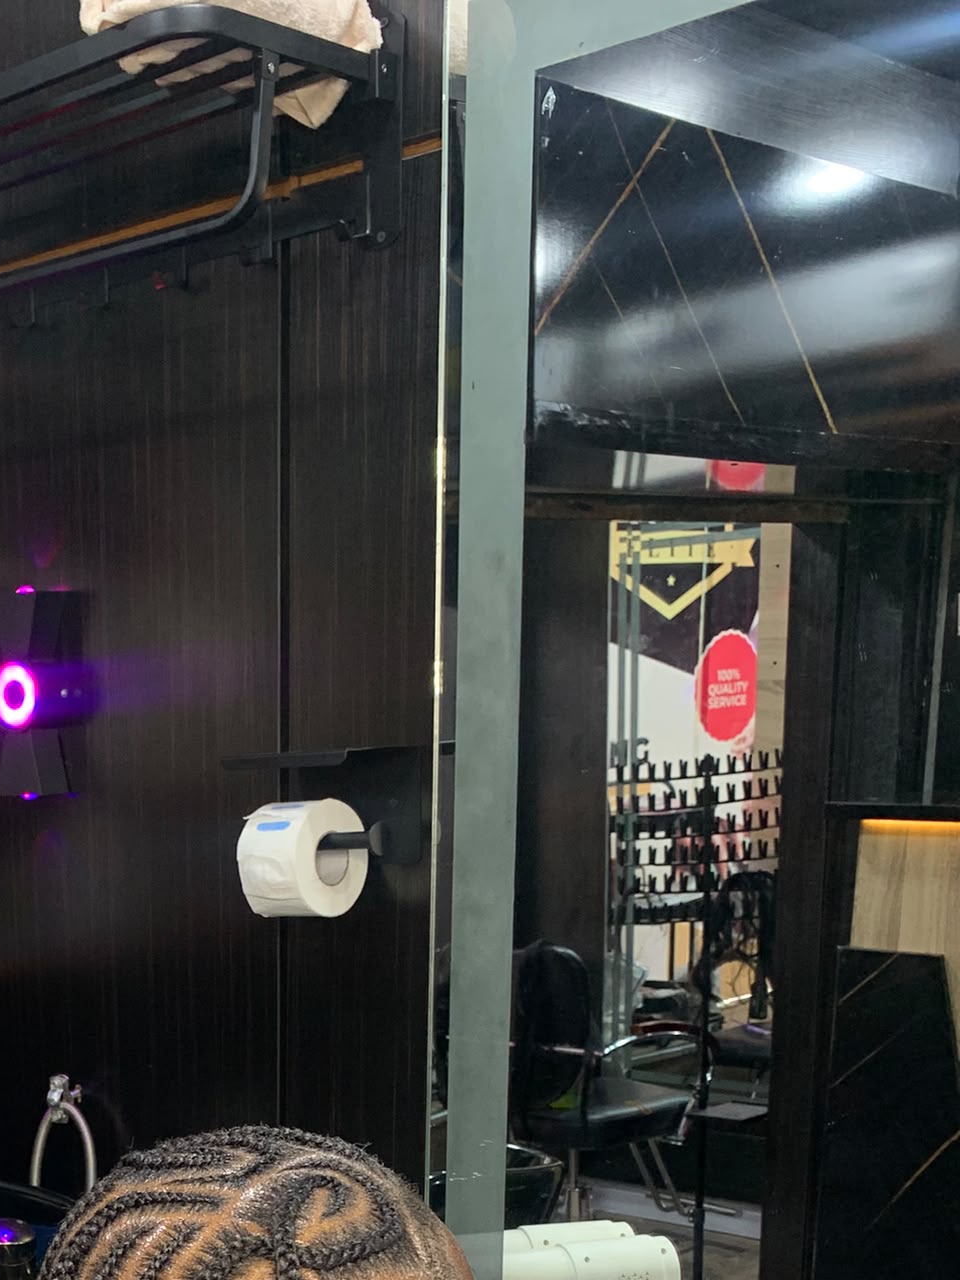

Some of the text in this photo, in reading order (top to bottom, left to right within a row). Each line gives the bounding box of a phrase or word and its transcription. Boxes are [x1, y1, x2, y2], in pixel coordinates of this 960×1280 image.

[716, 669, 741, 681] 100%
[707, 681, 749, 695] QUALITY
[707, 693, 747, 710] SERVICE
